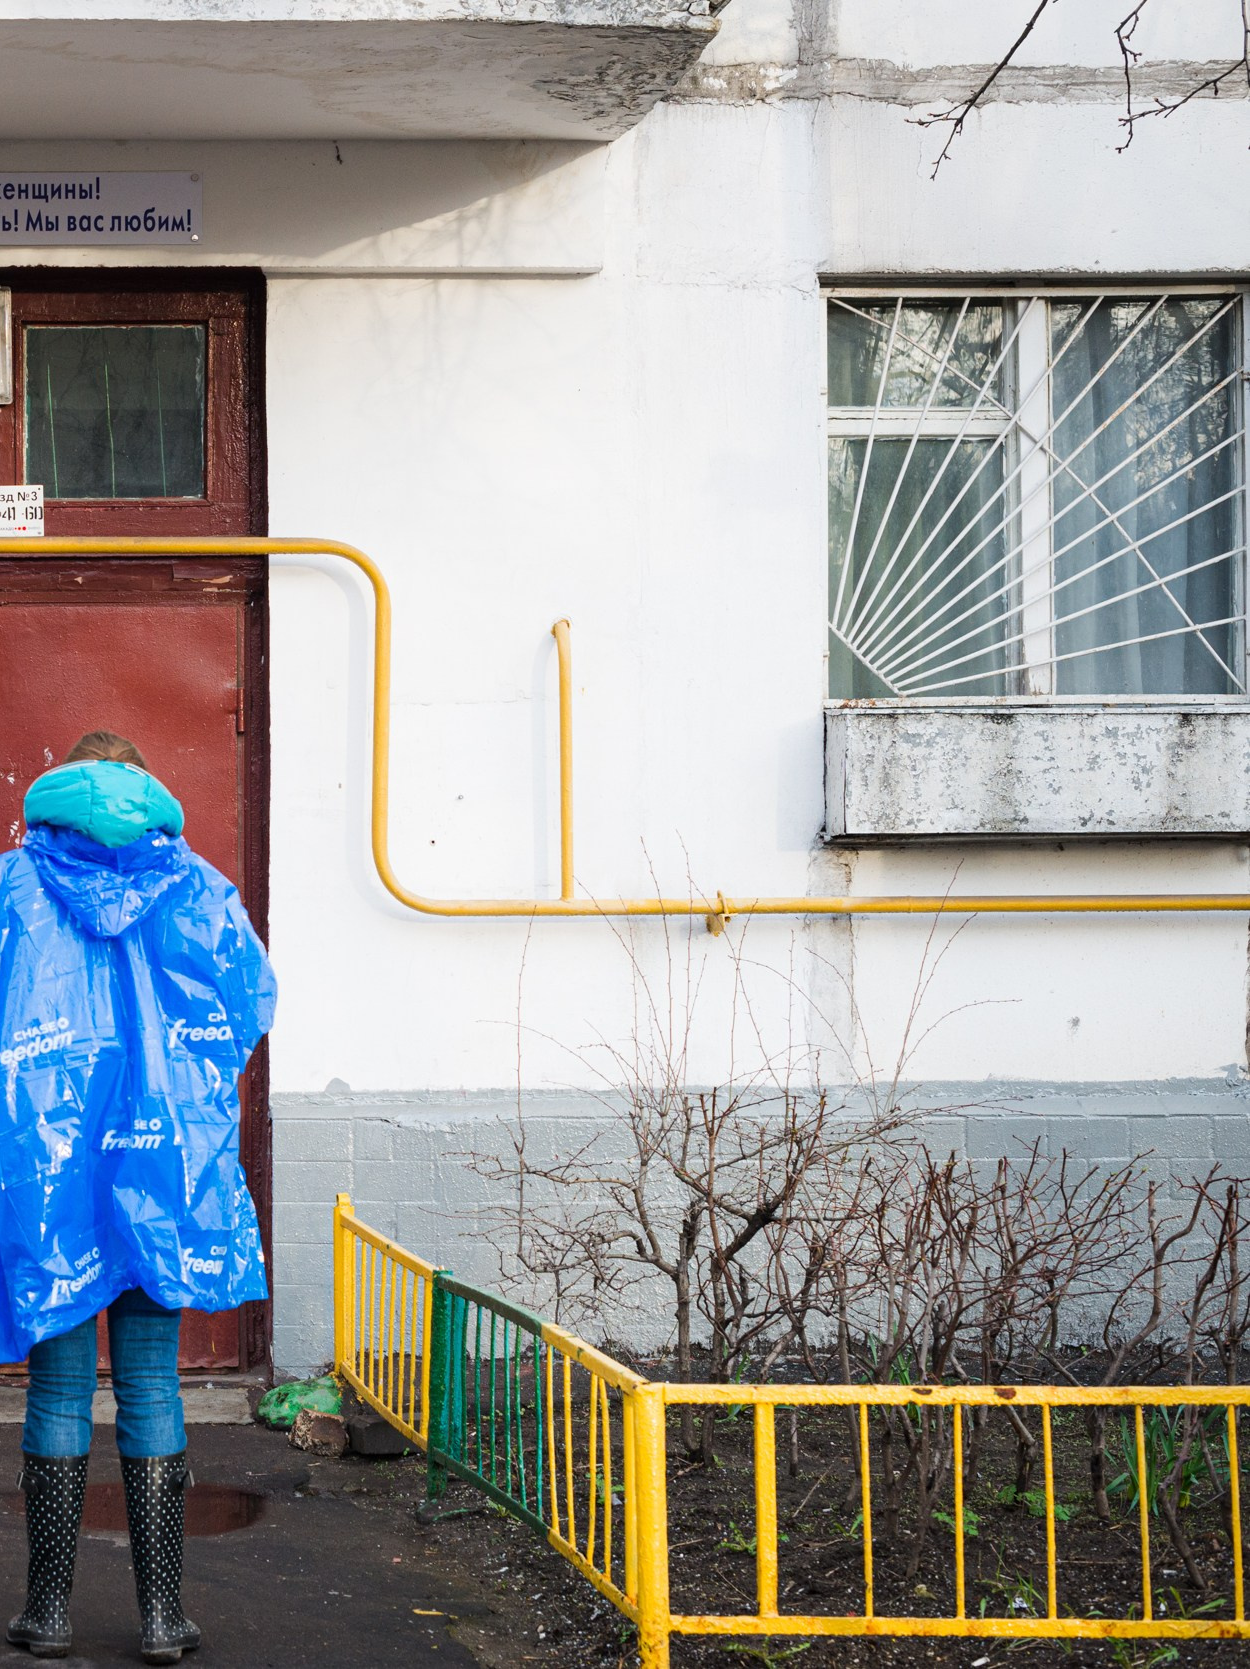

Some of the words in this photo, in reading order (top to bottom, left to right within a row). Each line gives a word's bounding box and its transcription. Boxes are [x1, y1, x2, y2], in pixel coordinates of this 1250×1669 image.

[25, 209, 59, 232] Мы
[67, 214, 104, 232] вас
[109, 206, 192, 233] любим!
[13, 1021, 57, 1042] CHASE
